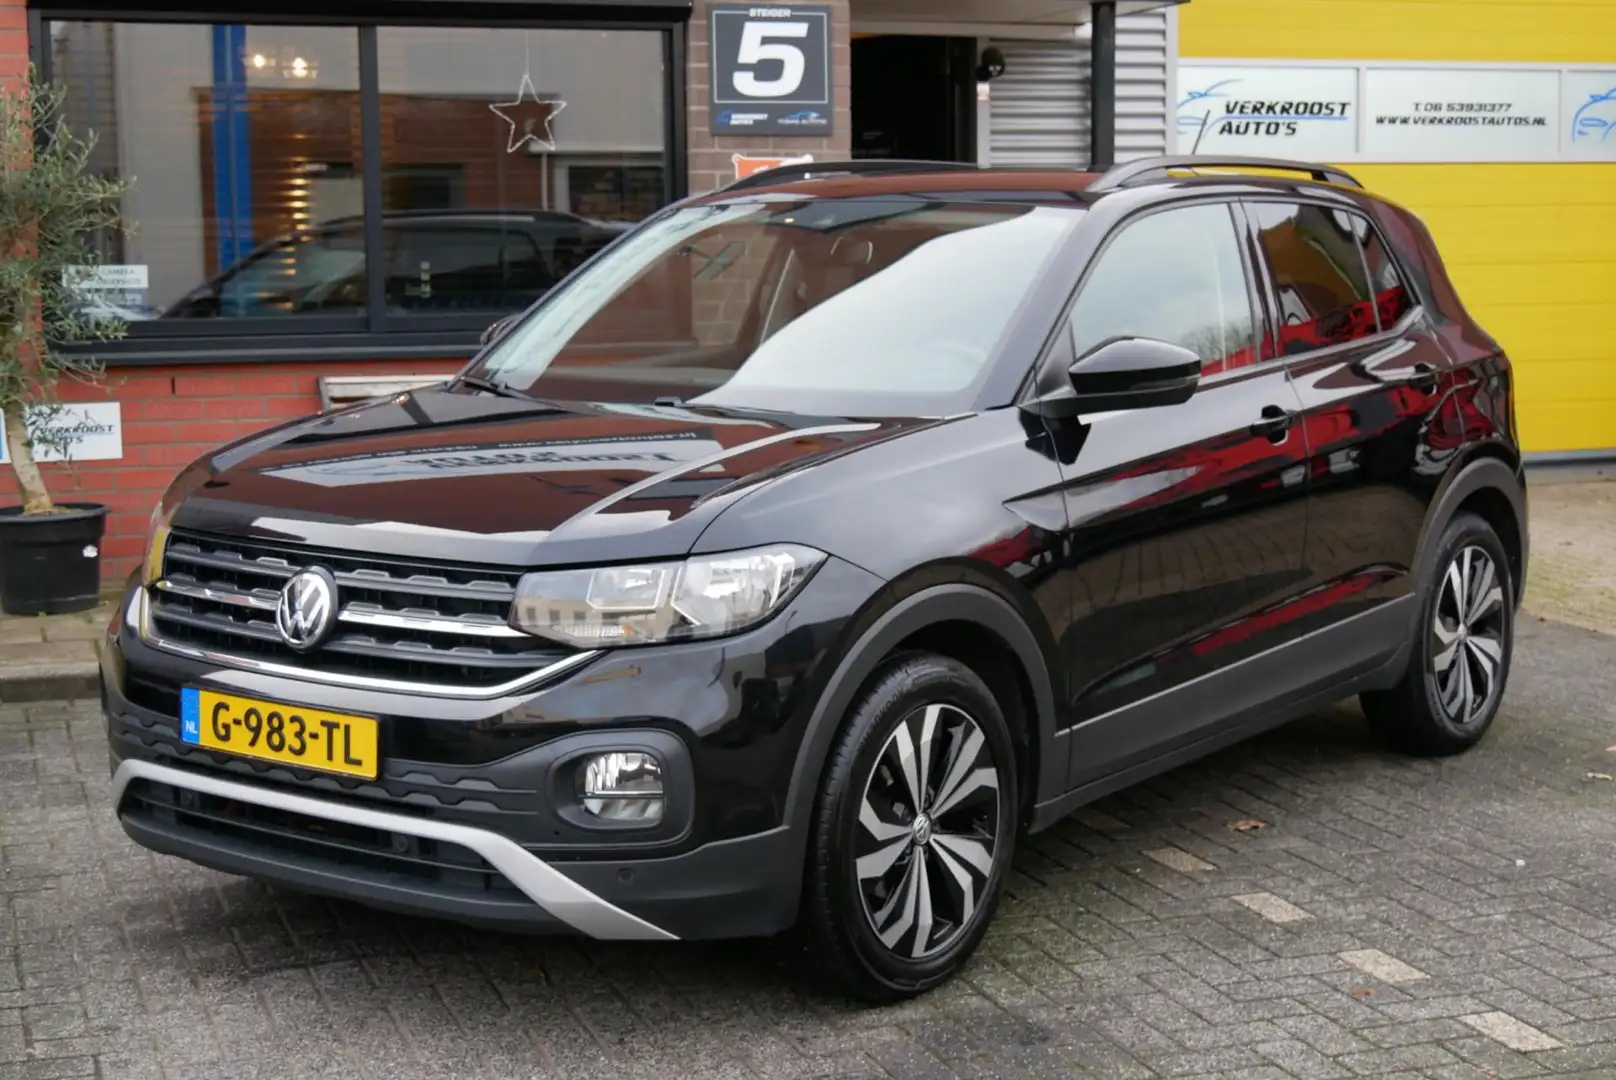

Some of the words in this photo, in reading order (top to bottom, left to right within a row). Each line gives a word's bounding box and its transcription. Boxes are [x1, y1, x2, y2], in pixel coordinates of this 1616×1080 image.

[733, 21, 809, 97] 5
[1225, 100, 1351, 116] VERKROOST
[1424, 102, 1443, 112] 06
[1219, 120, 1297, 136] AUTO'S
[185, 720, 199, 734] NL
[212, 701, 363, 767] G-983-TL
